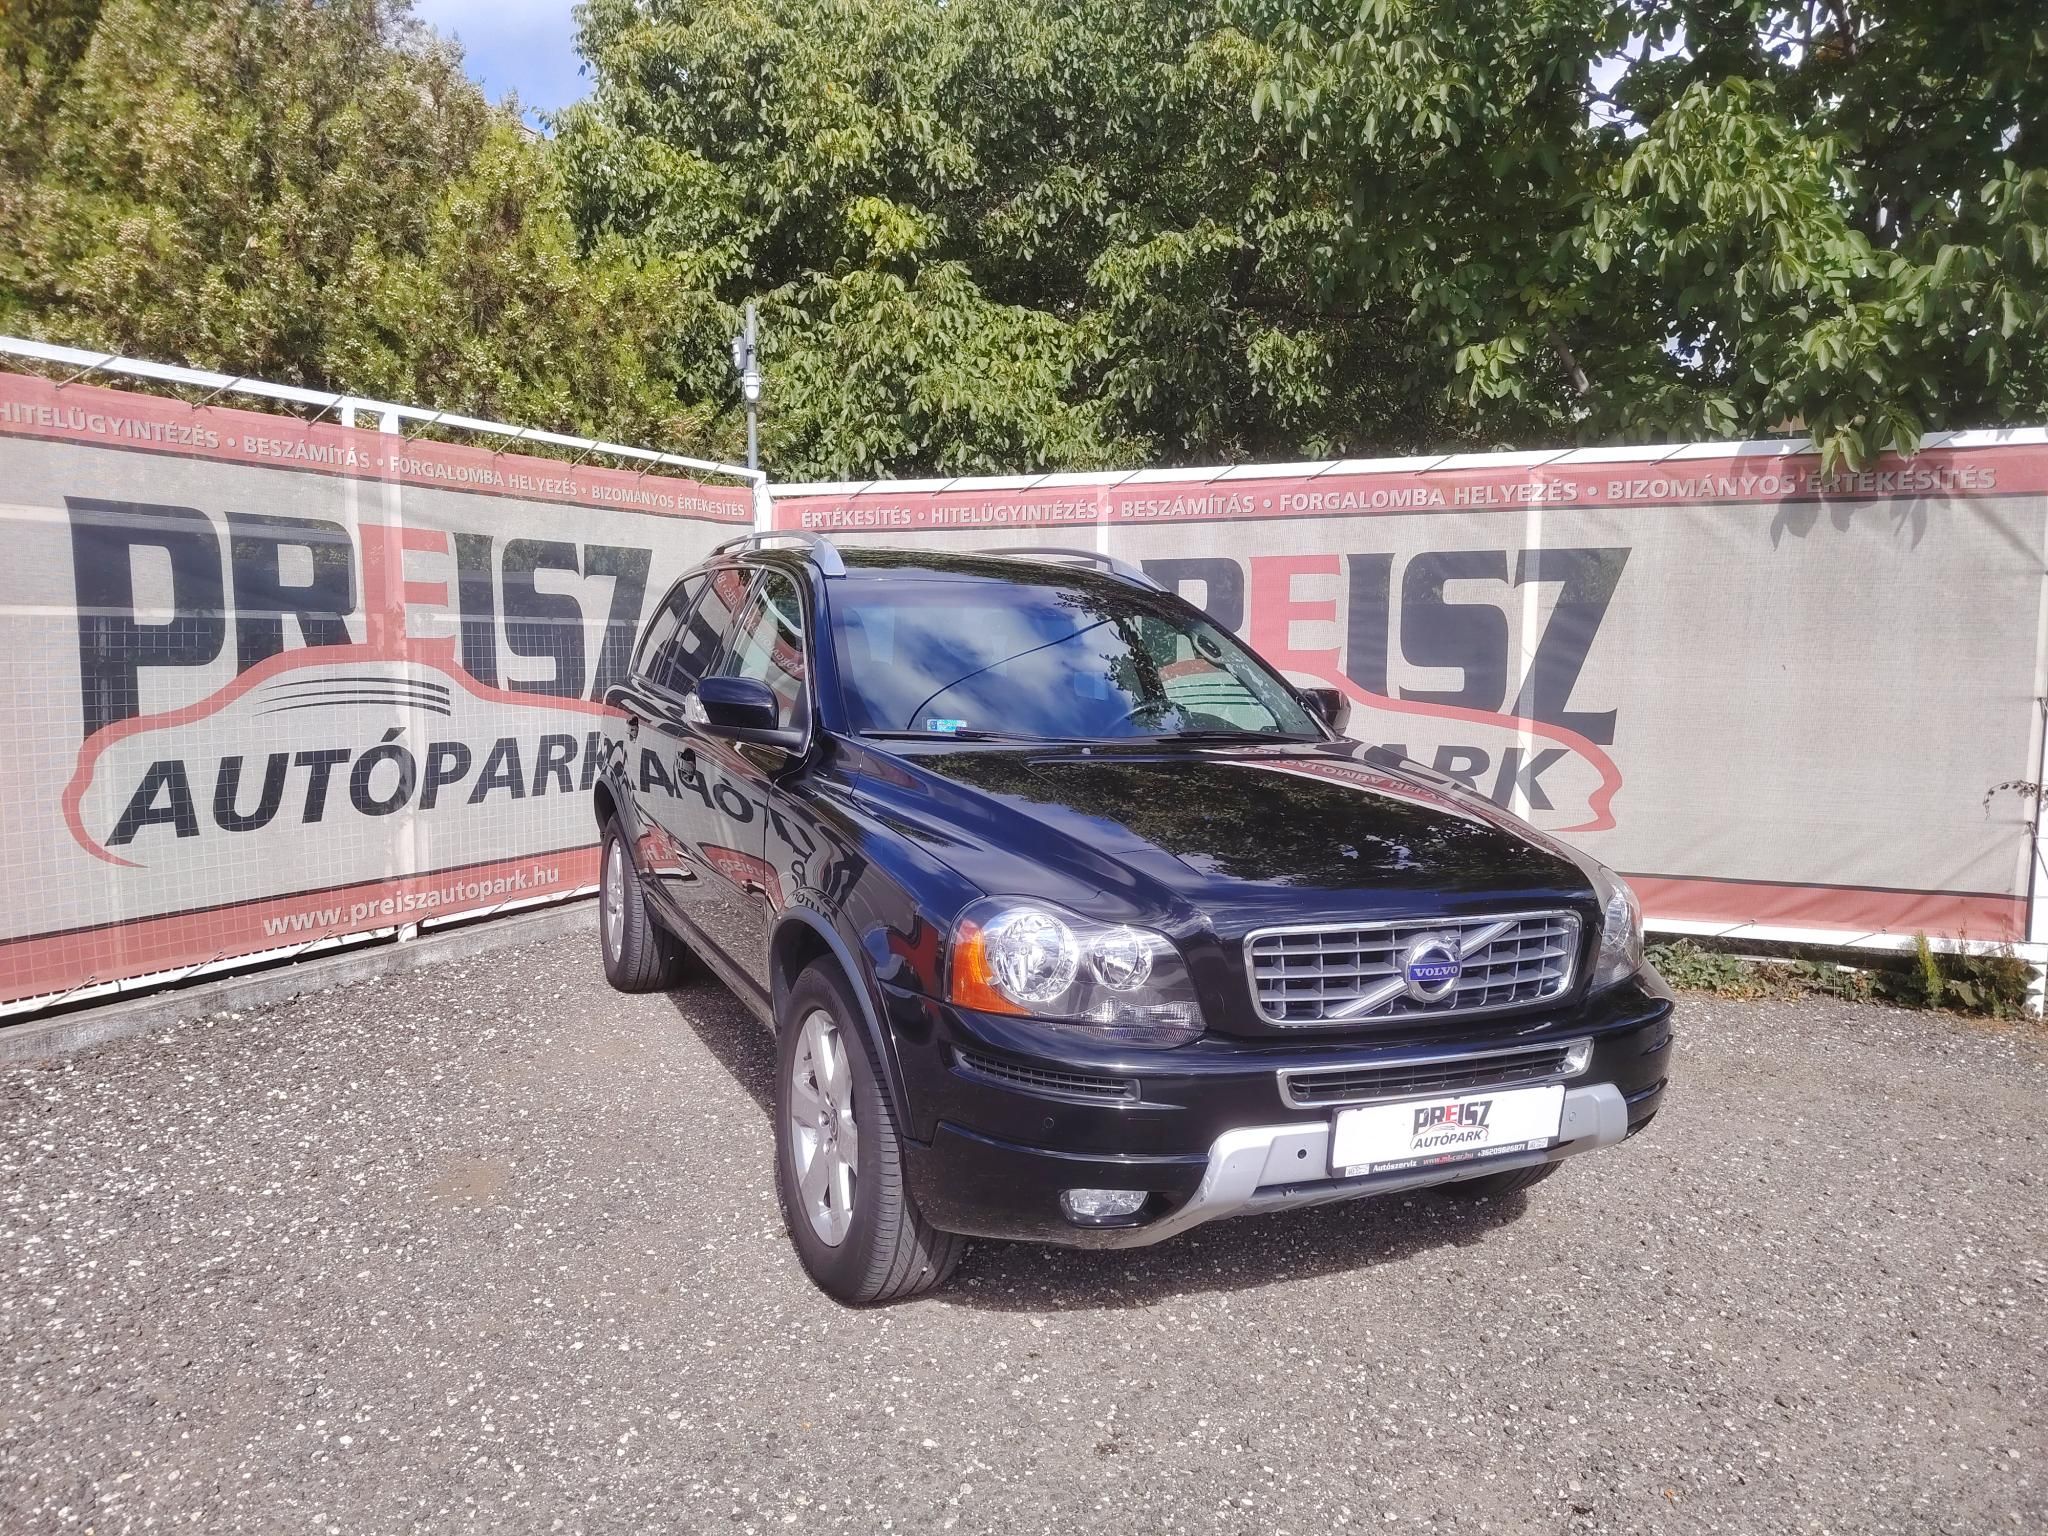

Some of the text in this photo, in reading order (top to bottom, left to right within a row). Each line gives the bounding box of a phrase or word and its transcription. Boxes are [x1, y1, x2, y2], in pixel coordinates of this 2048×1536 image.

[0, 402, 745, 516] HITELÜGYINTÉZÉS BESZÁMÍTÁS FORGALOMBA HELYEZÉS BIZOMÁNYOS ÉRTÉKESÍTÉS
[801, 507, 911, 528] ÉRTÉKESÍTÉS
[931, 498, 1098, 524] HITELÜGYINTÉZÉS
[1121, 492, 1255, 518] BESZÁMÍTÁS
[1279, 487, 1446, 511] FORGALOMBA
[1453, 477, 1578, 505] HELYEZÉS
[1607, 471, 1796, 499] BIZOMÁNYOS
[64, 496, 653, 743] PREISZ
[263, 865, 559, 937] www.preiszautopark.hu
[1413, 965, 1459, 978] VOLVO
[1412, 1100, 1493, 1135] PREISZ
[1413, 1129, 1483, 1150] AUTÓPARK
